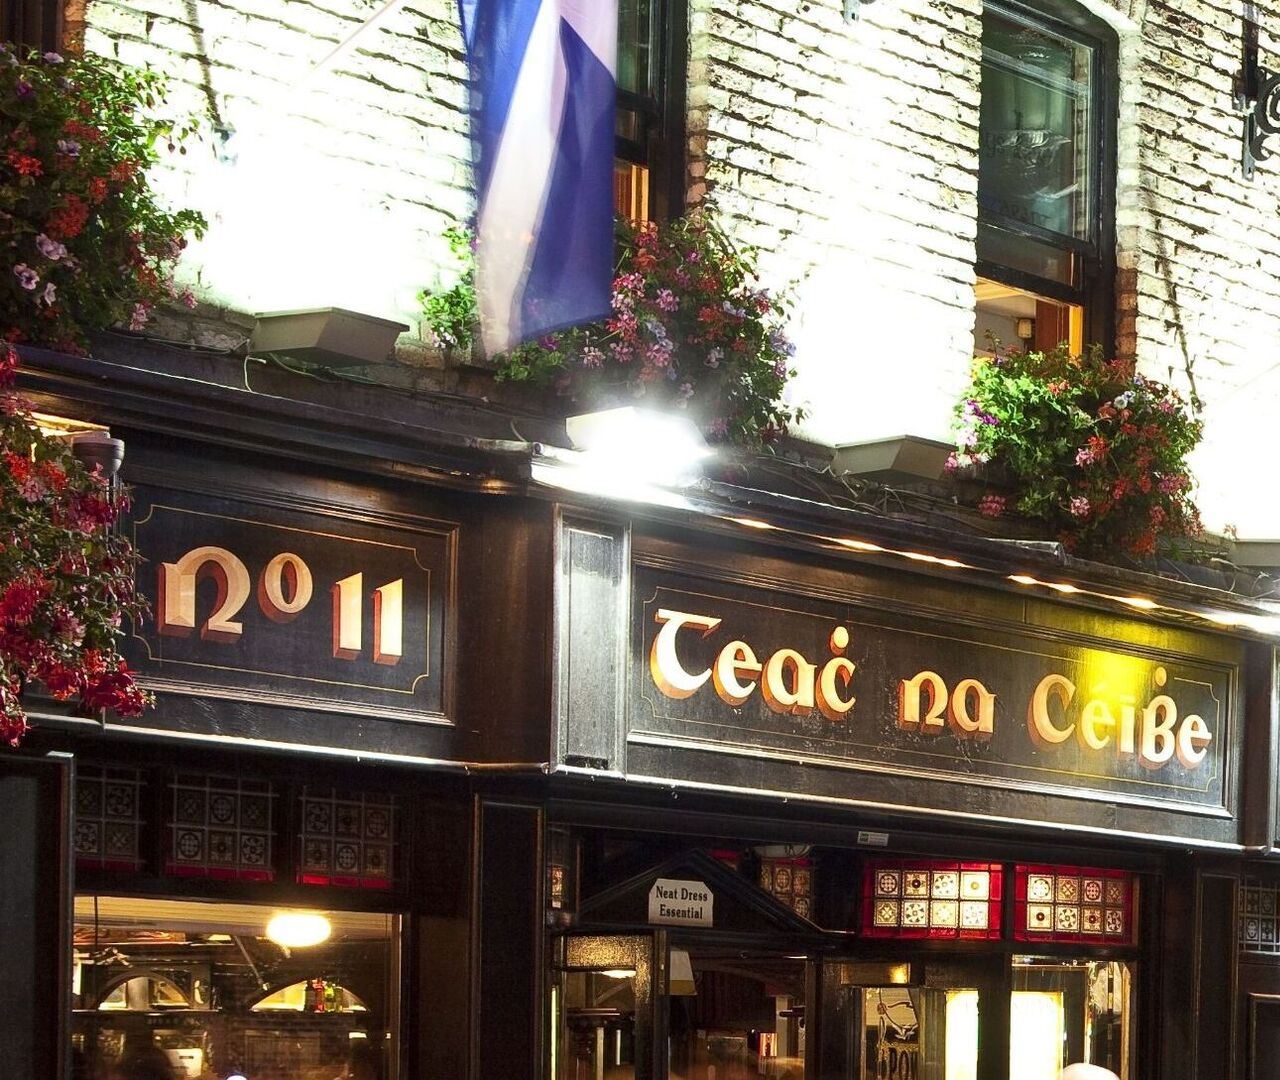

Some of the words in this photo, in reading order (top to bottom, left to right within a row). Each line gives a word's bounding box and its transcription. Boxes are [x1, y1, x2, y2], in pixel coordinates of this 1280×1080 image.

[898, 670, 997, 739] na
[655, 885, 679, 901] Neat
[680, 887, 709, 902] Dress
[659, 904, 704, 919] Essential
